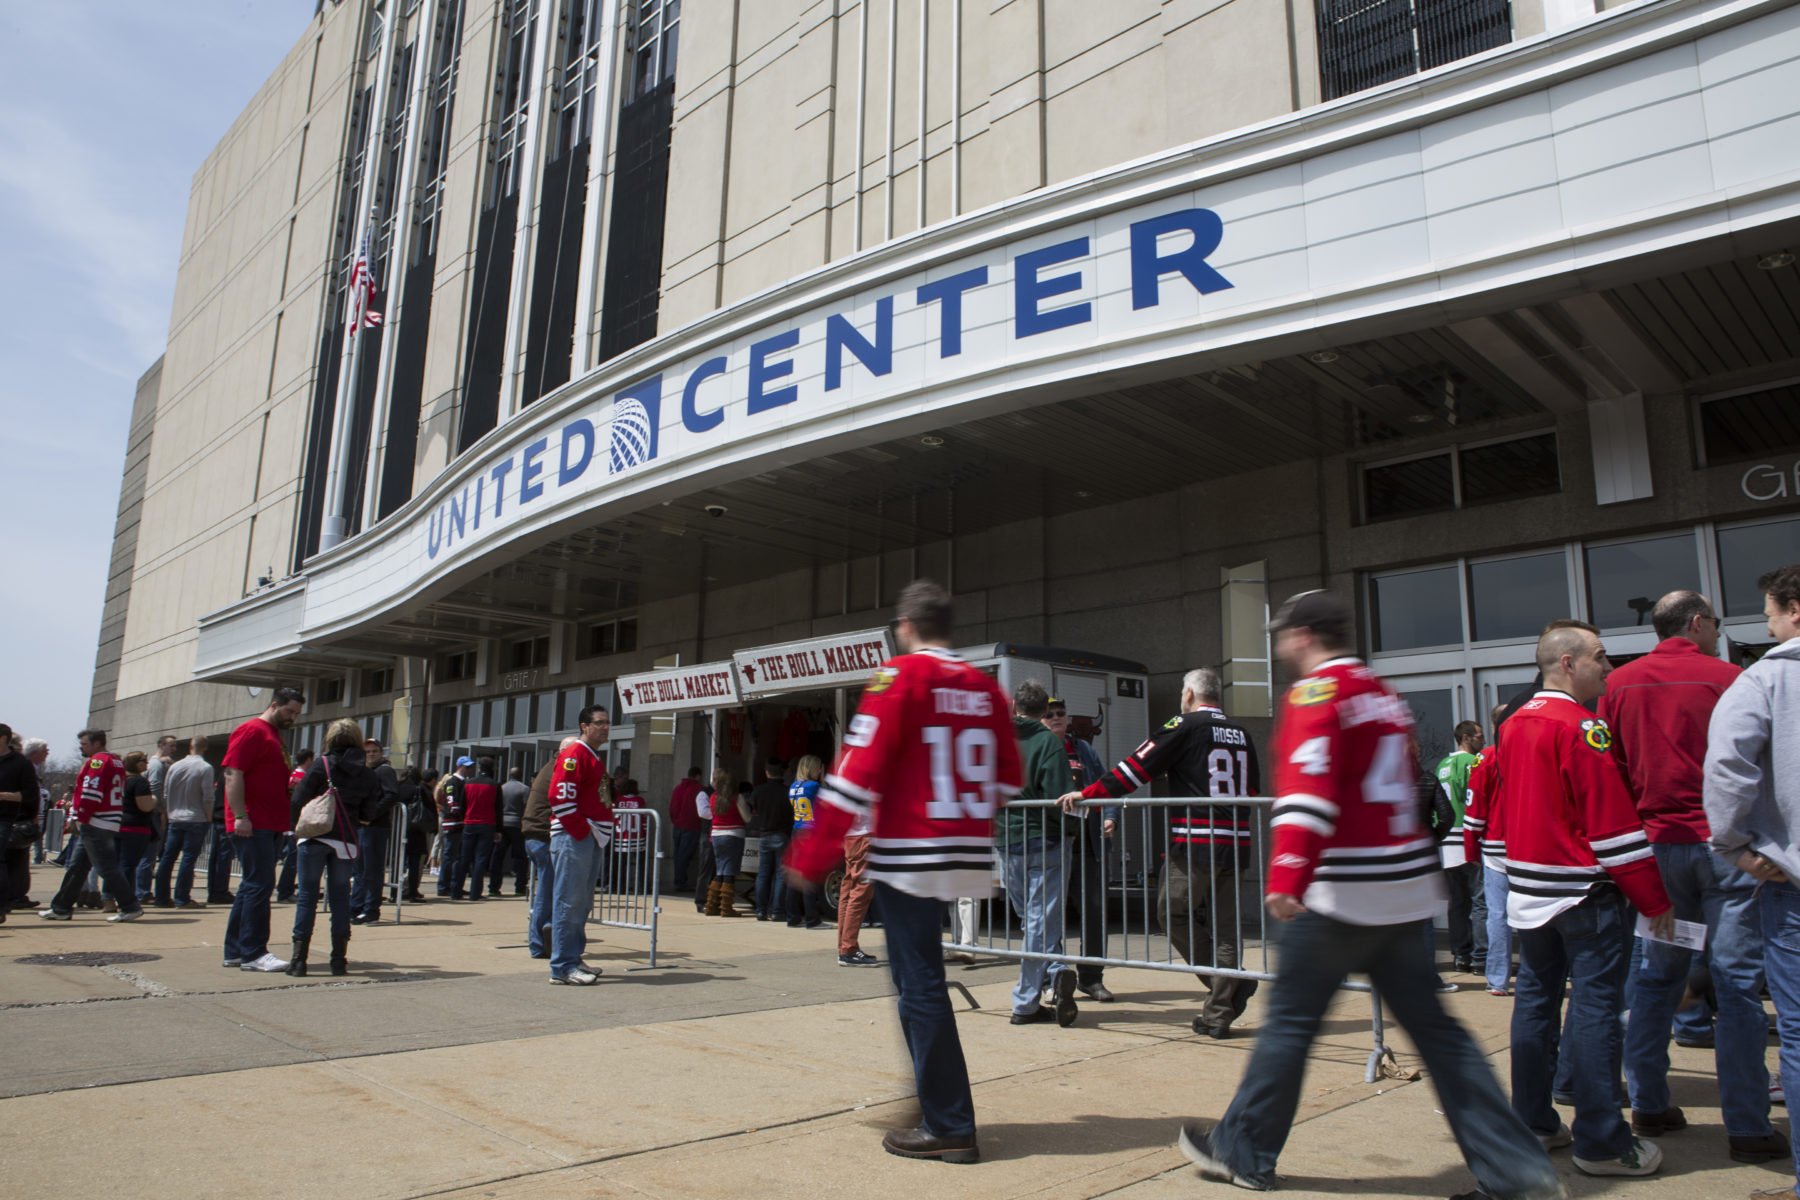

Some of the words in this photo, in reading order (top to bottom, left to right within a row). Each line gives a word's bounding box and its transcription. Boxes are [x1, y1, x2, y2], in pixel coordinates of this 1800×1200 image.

[428, 418, 595, 560] UNITED
[681, 208, 1235, 433] CENTER
[1741, 460, 1800, 500] G
[757, 655, 788, 682] THE
[785, 651, 824, 679] BULL
[823, 641, 885, 674] MARKET
[504, 671, 529, 690] GATE
[531, 670, 539, 687] 7
[634, 681, 658, 704] THE
[656, 678, 685, 702] BULL
[684, 671, 731, 699] MARKET
[1212, 726, 1247, 747] HOSSA
[82, 775, 100, 789] 24
[921, 726, 997, 820] 19
[1207, 748, 1248, 798] 81
[110, 774, 125, 807] 2
[556, 782, 577, 799] 35
